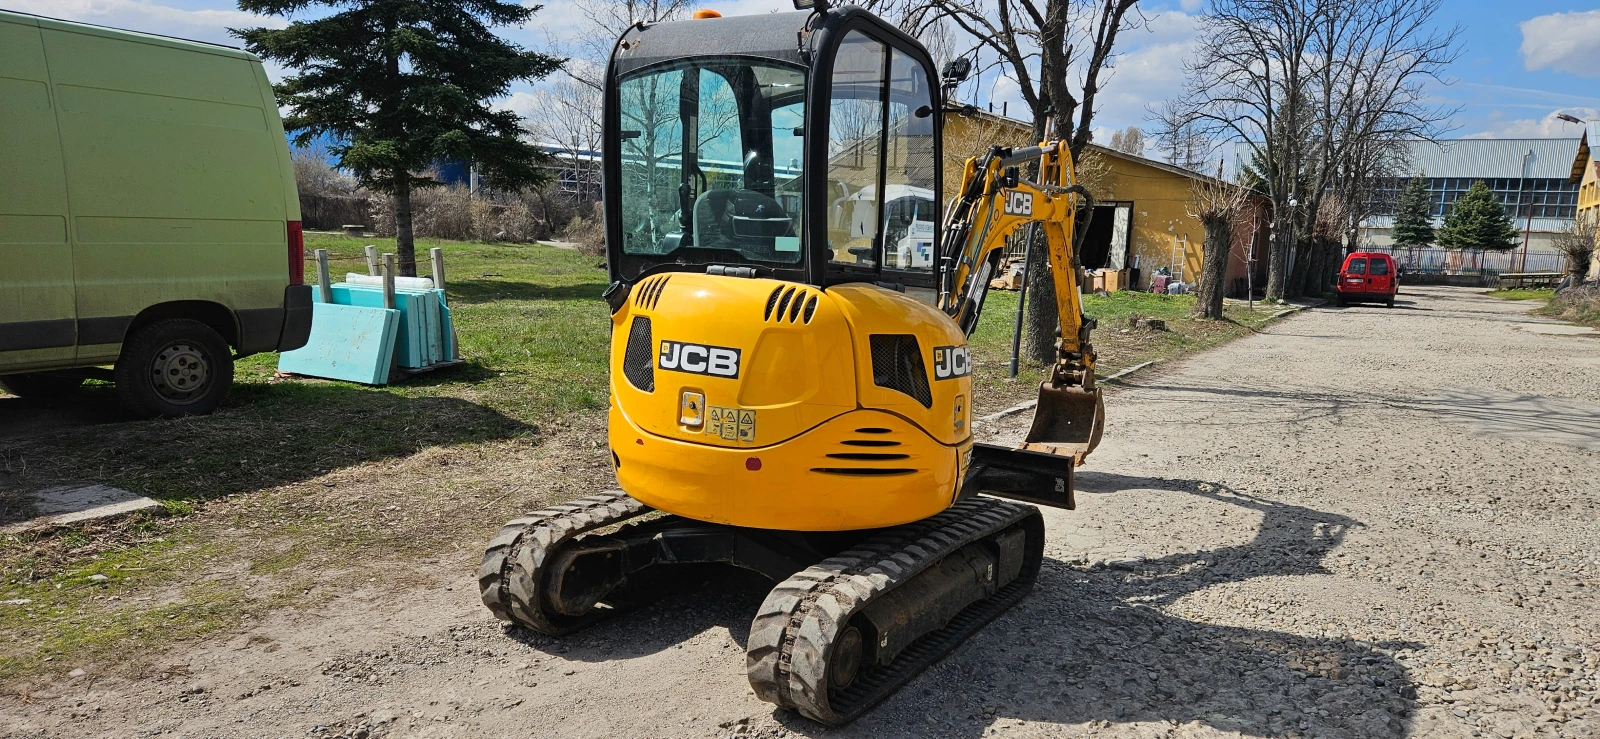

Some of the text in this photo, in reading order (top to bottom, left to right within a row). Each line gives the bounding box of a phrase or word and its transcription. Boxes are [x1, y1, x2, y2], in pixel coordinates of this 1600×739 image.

[1005, 191, 1032, 215] JCB
[660, 343, 738, 376] JCB
[936, 347, 972, 378] JCB
